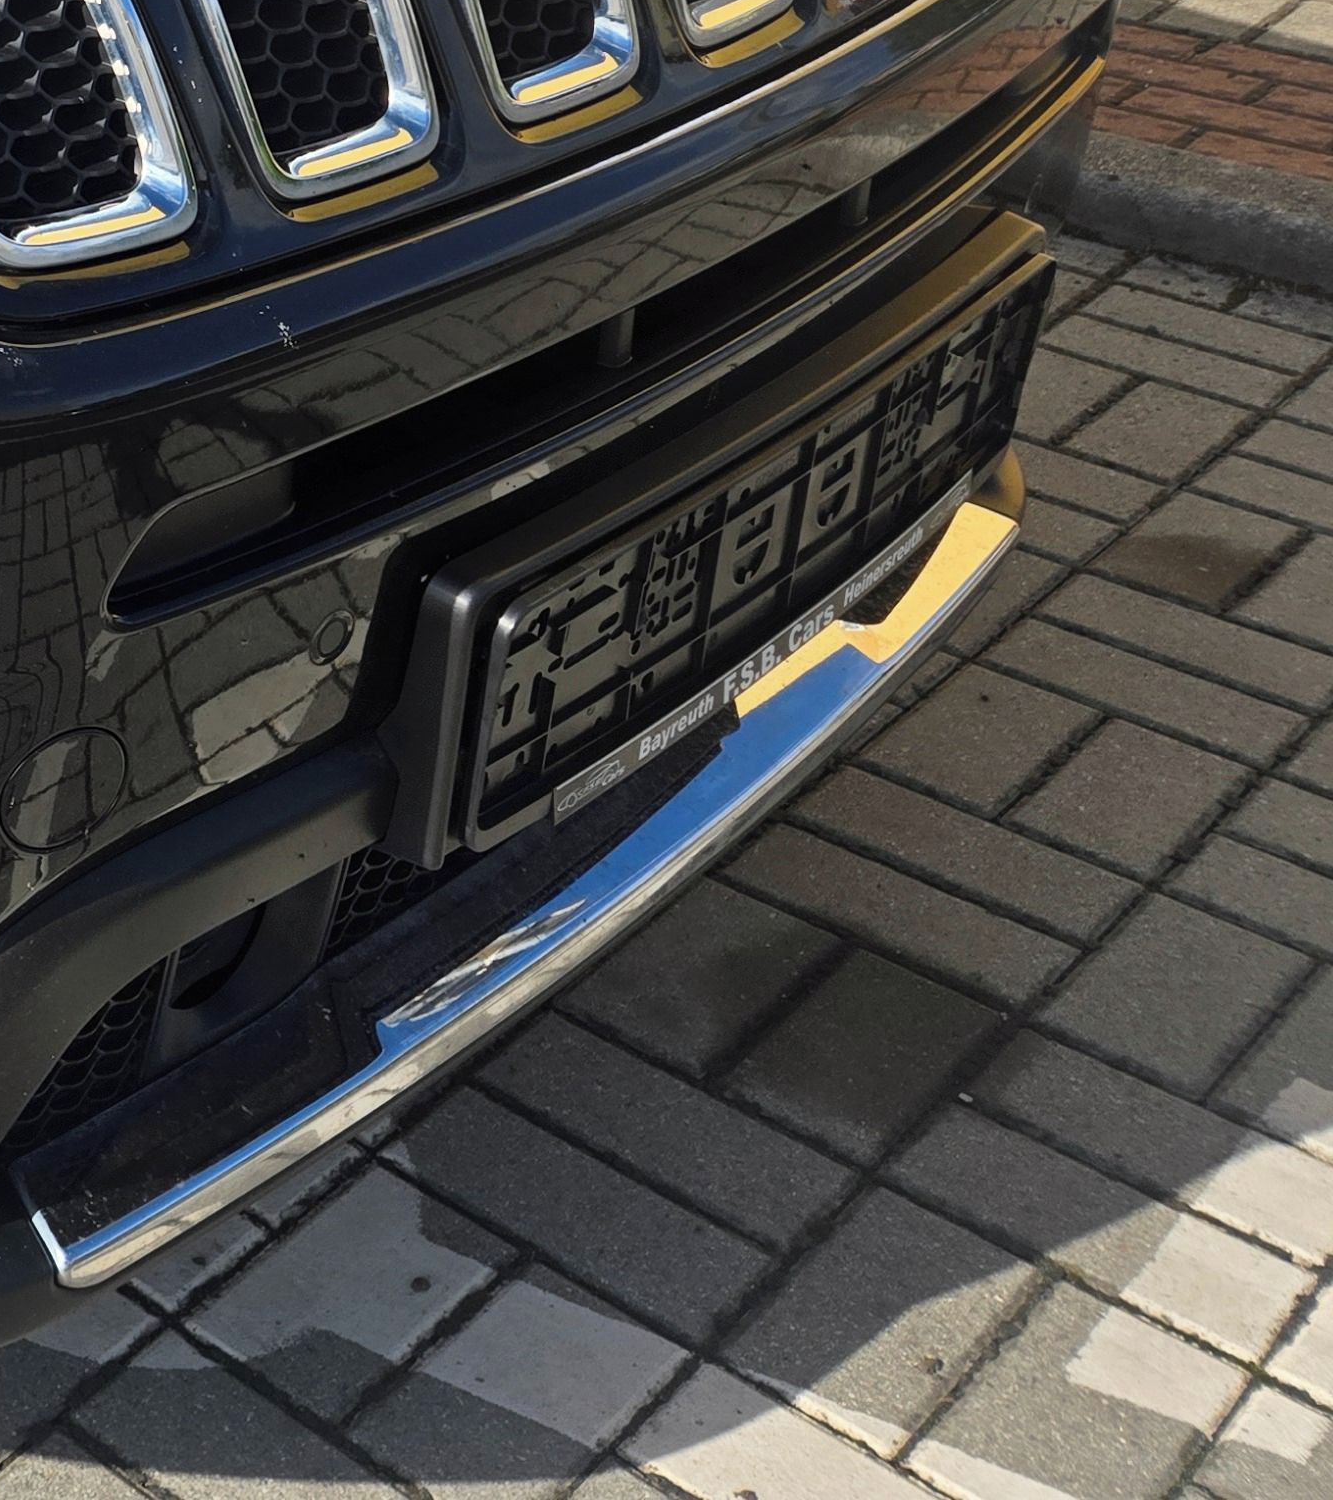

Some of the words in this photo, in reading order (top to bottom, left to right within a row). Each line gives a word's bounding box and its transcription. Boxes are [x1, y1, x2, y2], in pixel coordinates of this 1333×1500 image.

[638, 694, 715, 761] Bayreuth
[723, 642, 782, 704] F.S.B.
[788, 604, 834, 652] Cars
[843, 526, 924, 608] Heinersreuth
